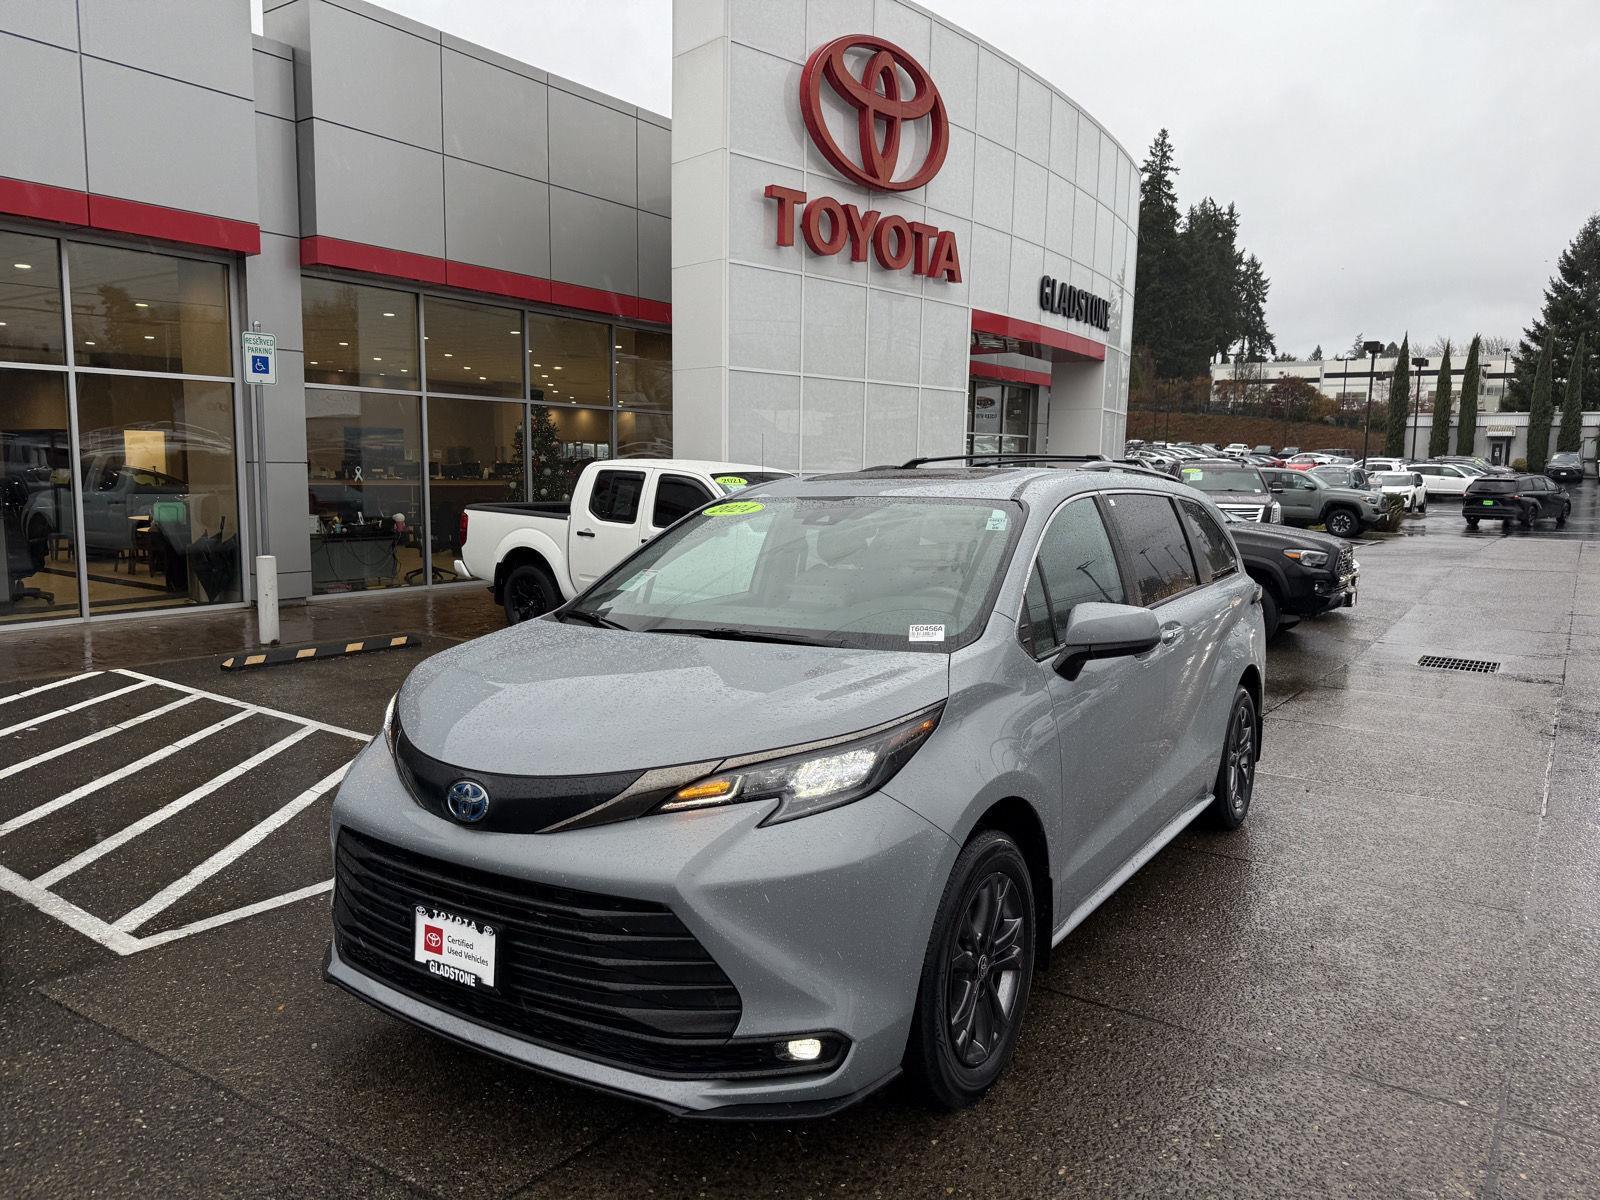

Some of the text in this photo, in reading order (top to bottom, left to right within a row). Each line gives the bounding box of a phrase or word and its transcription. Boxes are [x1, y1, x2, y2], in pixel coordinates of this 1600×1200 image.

[764, 184, 962, 283] TOYOTA
[1040, 275, 1111, 332] GLADSTONE
[245, 337, 274, 346] RESERVED
[247, 346, 273, 355] PARKING
[433, 909, 477, 931] TOYOTA
[447, 935, 474, 951] Certified
[447, 946, 489, 967] Used Vehicles
[429, 961, 476, 987] GLADSTONE
